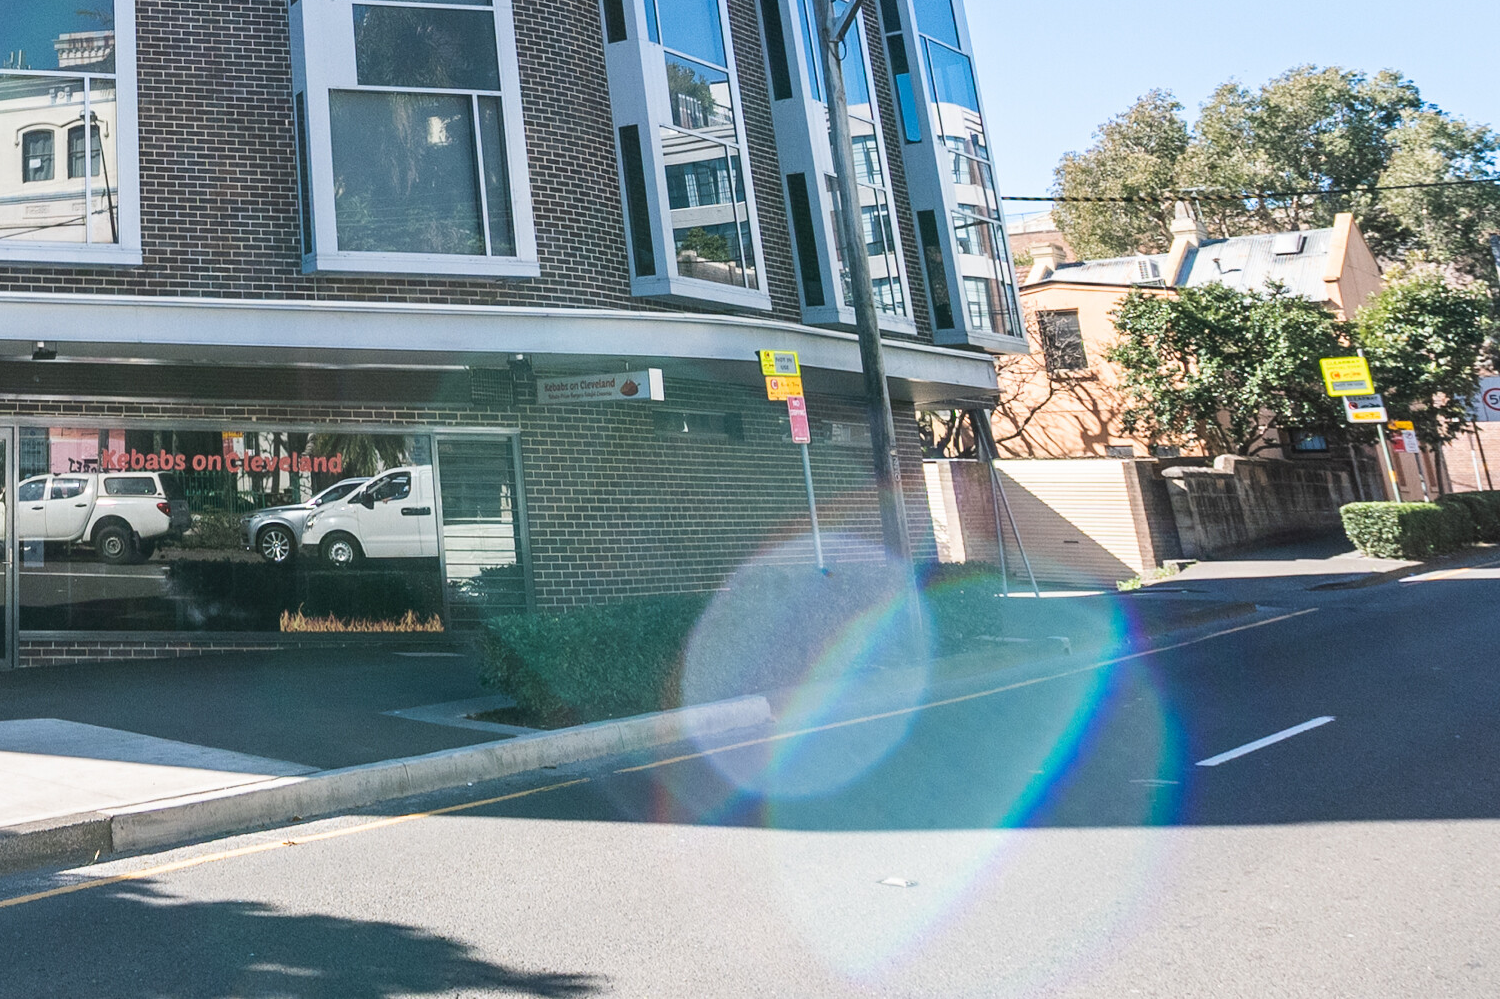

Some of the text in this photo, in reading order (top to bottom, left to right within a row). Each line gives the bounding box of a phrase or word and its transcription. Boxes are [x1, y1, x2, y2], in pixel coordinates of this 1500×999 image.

[580, 377, 615, 390] Cleveland
[102, 448, 186, 471] Kebabs
[192, 454, 222, 471] on
[225, 452, 343, 473] Cleveland
